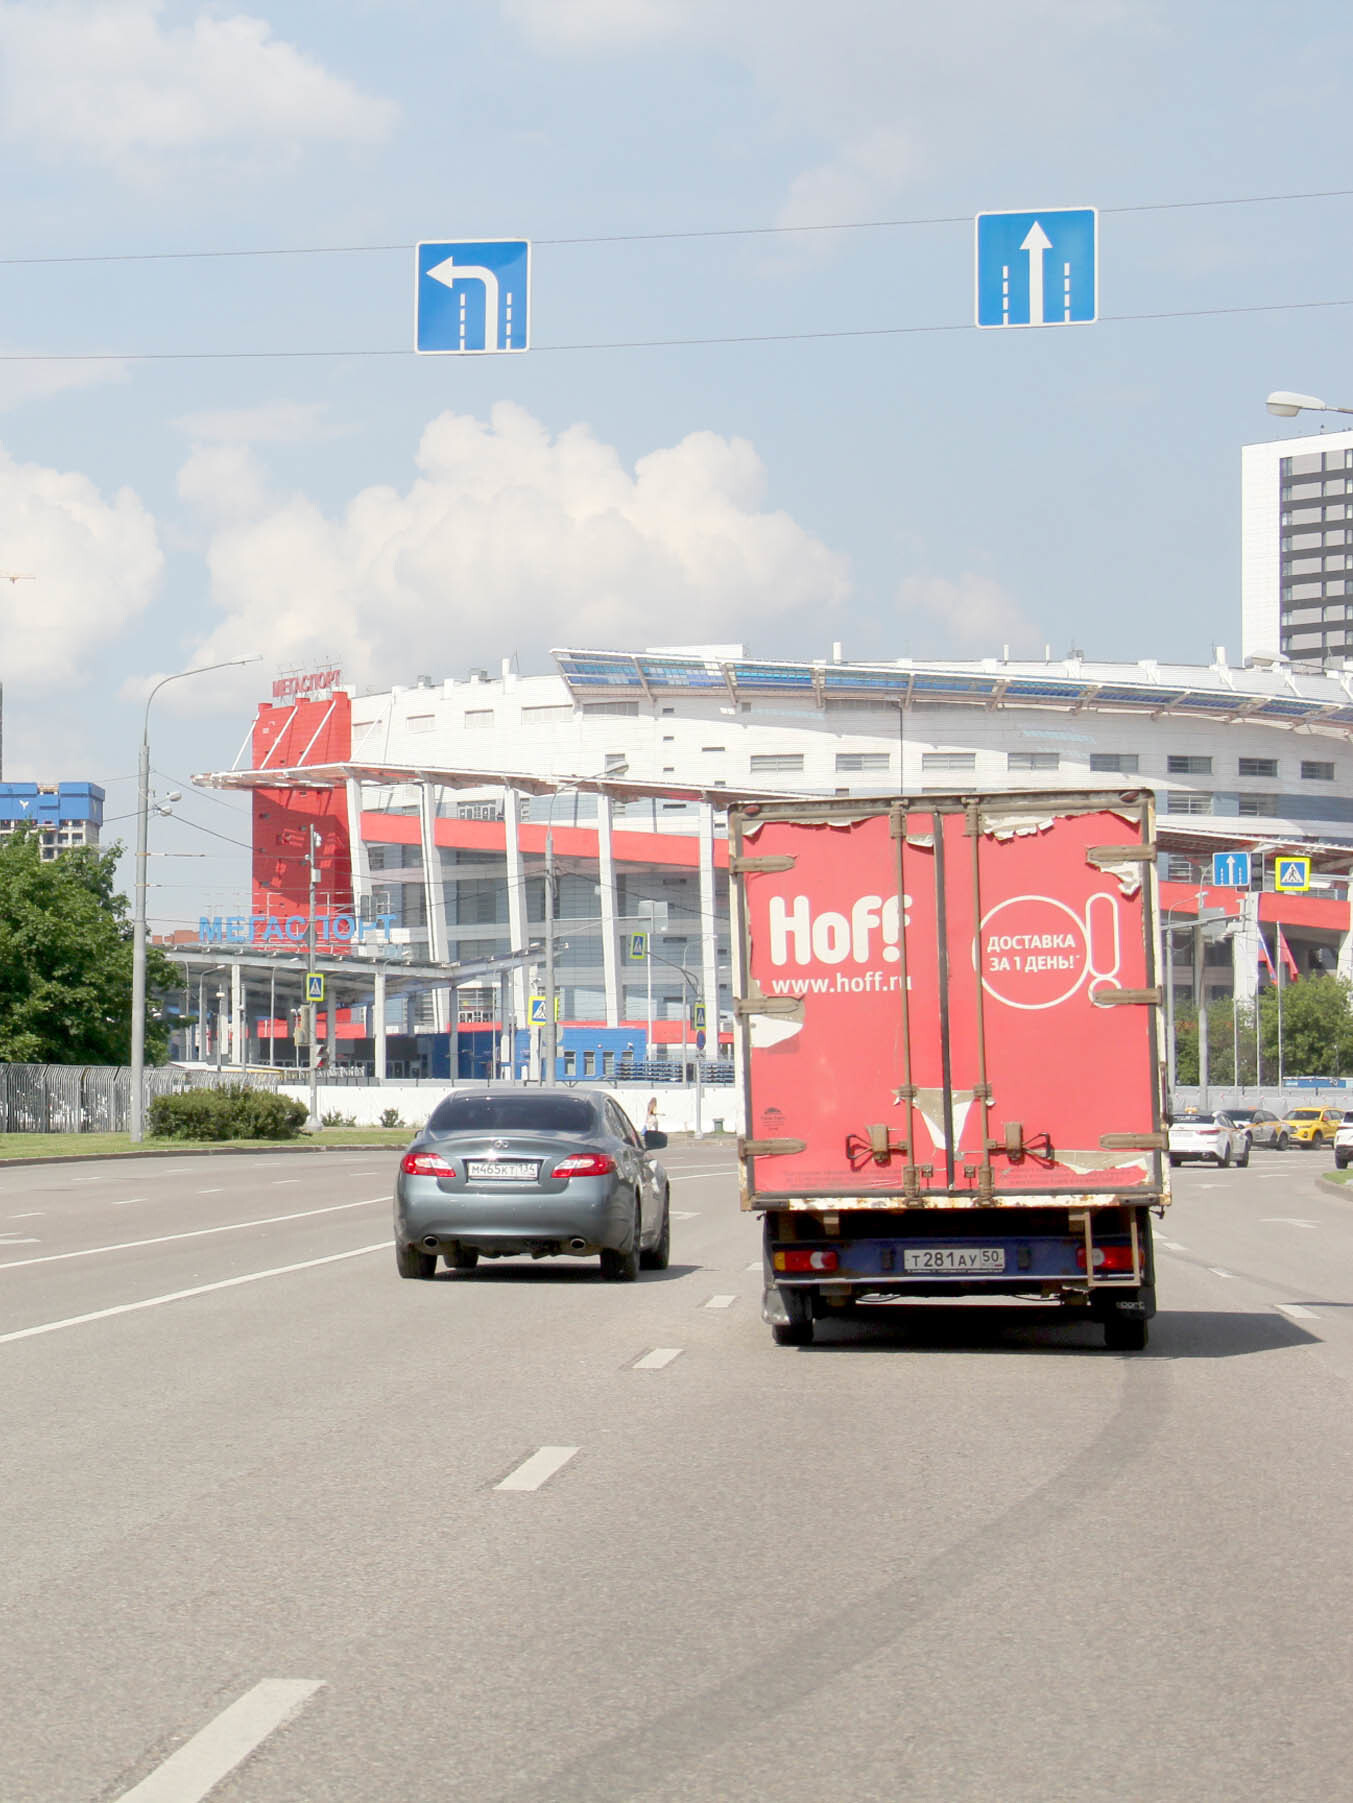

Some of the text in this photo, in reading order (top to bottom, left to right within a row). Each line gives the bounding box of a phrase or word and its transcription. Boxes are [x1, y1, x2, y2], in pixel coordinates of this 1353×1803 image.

[986, 933, 1076, 953] ДОСТАВКА
[989, 956, 1010, 971] ЗА
[1013, 956, 1021, 971] 1
[982, 1250, 999, 1262] 50
